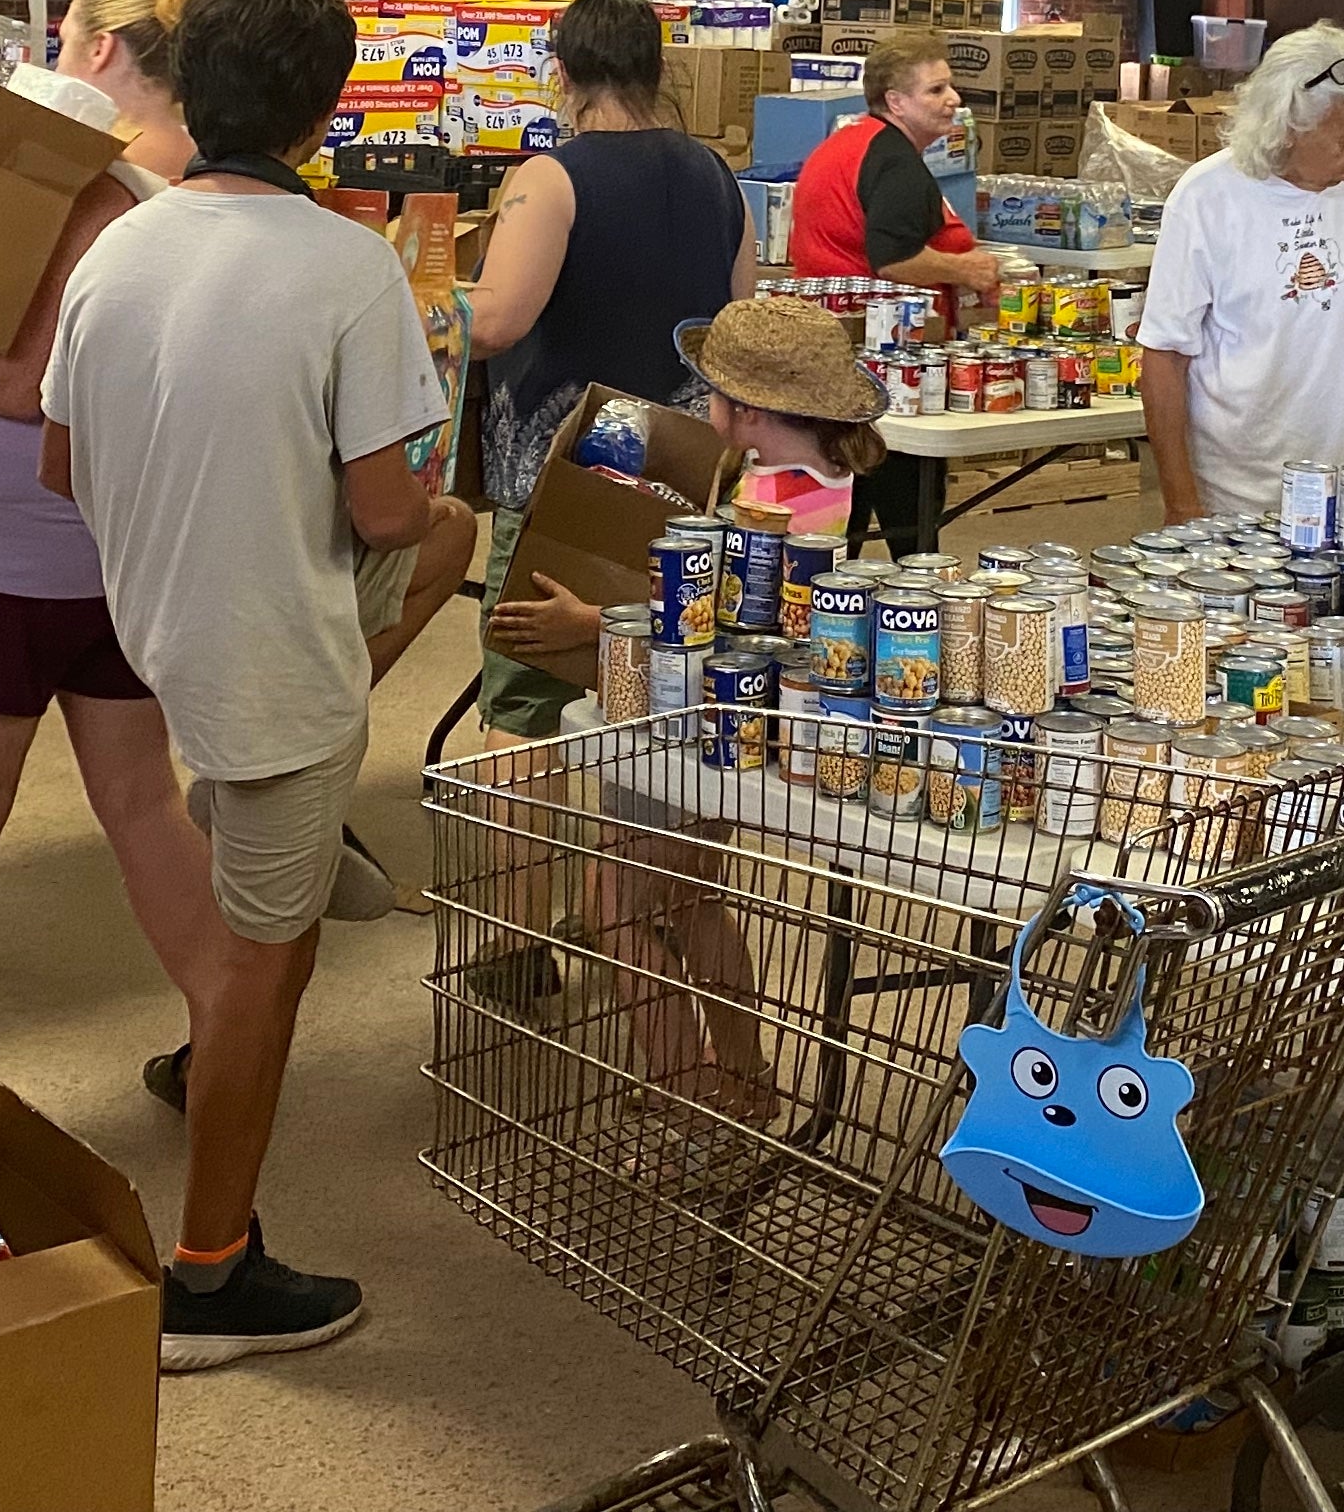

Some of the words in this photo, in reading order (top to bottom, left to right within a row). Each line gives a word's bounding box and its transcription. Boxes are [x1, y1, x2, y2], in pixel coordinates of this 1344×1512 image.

[457, 27, 479, 40] POM
[486, 48, 497, 58] 45
[503, 44, 523, 57] 473
[785, 39, 819, 52] QUILTE
[833, 40, 874, 55] QUILTE
[361, 46, 385, 61] 473
[394, 46, 405, 57] 45
[413, 63, 440, 76] POM
[486, 115, 505, 129] 473
[509, 114, 522, 127] 45
[383, 131, 406, 144] 473
[529, 133, 553, 147] POM
[992, 213, 1032, 230] Splash
[726, 532, 744, 550] YA
[686, 554, 712, 572] GO
[813, 590, 864, 611] GOYA
[882, 609, 937, 630] GOYA
[739, 674, 767, 695] GO
[1002, 718, 1030, 739] OY
